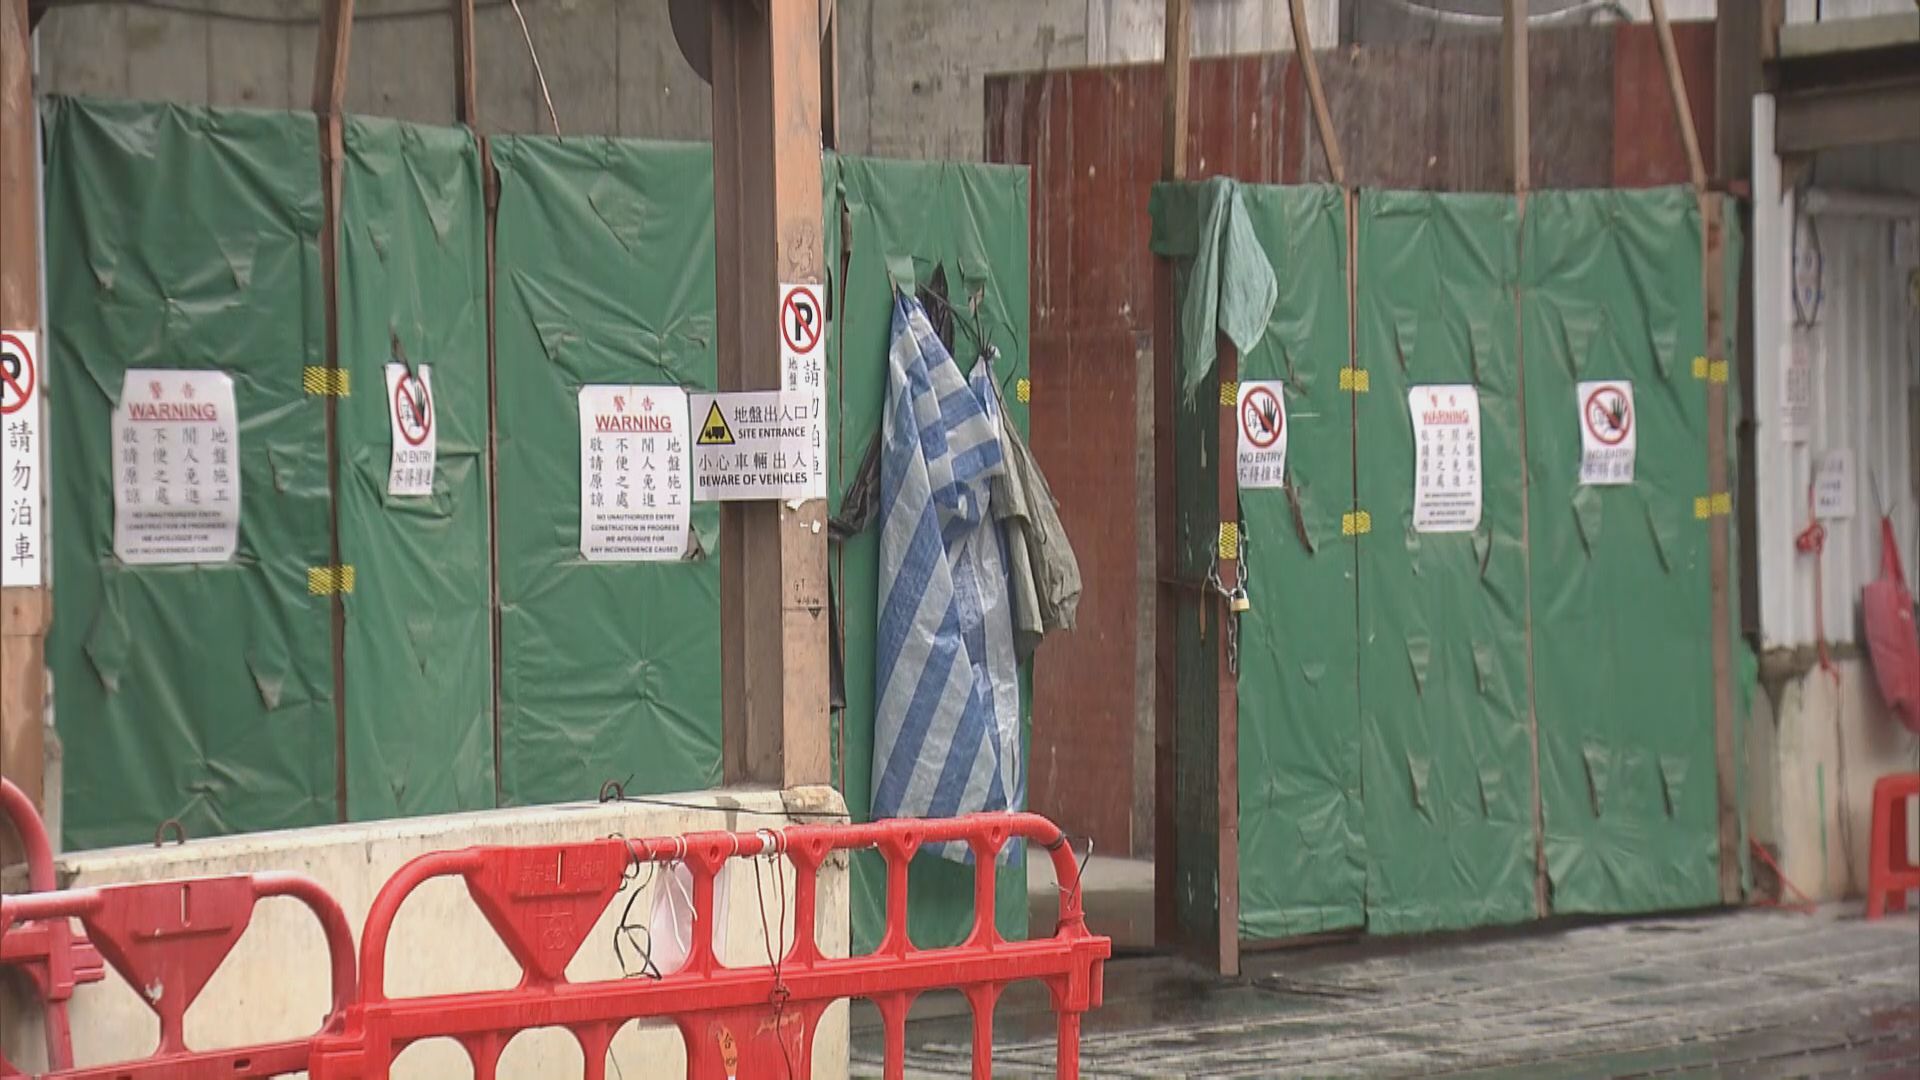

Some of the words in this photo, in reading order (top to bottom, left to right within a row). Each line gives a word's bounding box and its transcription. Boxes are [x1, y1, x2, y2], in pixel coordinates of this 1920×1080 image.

[128, 402, 217, 418] WARNING
[613, 395, 655, 413] 警告
[595, 415, 672, 432] WARNING
[734, 405, 808, 424] 地盤出入口
[738, 428, 756, 439] SITE
[758, 426, 806, 438] ENTRANCE
[396, 450, 408, 463] NO
[409, 450, 432, 463] ENTRY
[698, 451, 807, 471] 小心車輛出入
[1239, 452, 1254, 463] NO
[1255, 451, 1282, 463] ENTRY
[589, 436, 604, 508] 敬請原諒
[615, 437, 629, 509] 不便之處
[666, 436, 682, 506] 地盤施工
[699, 474, 741, 487] BEWARE
[742, 473, 757, 485] OF
[758, 472, 808, 486] VEHICLES
[8, 420, 35, 568] 請勿泊車
